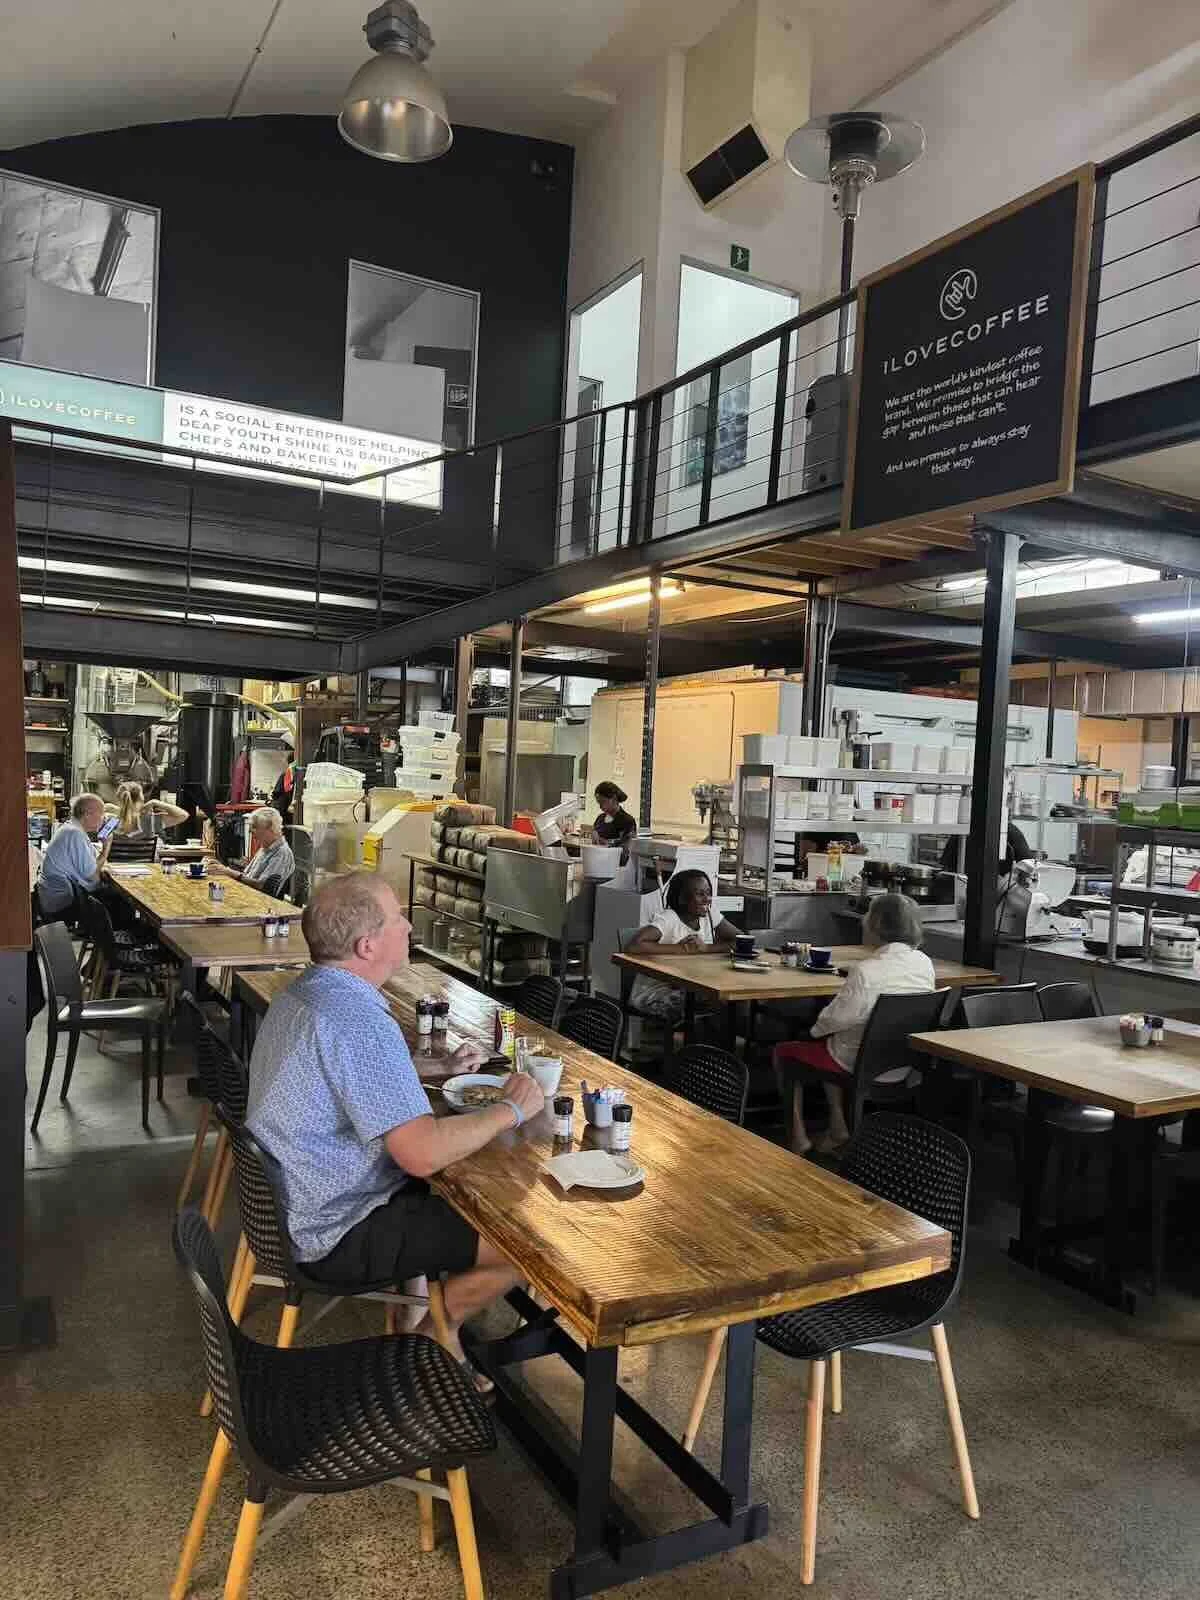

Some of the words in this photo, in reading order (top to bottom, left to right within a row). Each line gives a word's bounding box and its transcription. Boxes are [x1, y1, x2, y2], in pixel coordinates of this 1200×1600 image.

[882, 294, 1049, 375] ILOVECOFFEE
[885, 398, 900, 409] We
[901, 391, 915, 403] are
[916, 386, 932, 399] the
[970, 357, 1006, 378] kindest
[1008, 344, 1043, 364] coffee
[916, 398, 932, 411] We
[972, 380, 984, 392] to
[986, 367, 1020, 387] bridge
[1021, 361, 1040, 375] the
[11, 392, 137, 426] ILOVECOFFEE
[902, 411, 941, 430] between
[971, 391, 993, 406] that
[994, 386, 1013, 400] can
[1015, 376, 1041, 392] hear
[178, 431, 233, 449] CHEFS
[239, 441, 272, 456] AND
[277, 448, 338, 468] BAKERS
[342, 460, 357, 472] IN
[179, 403, 194, 416] IS
[199, 408, 209, 418] A
[215, 410, 272, 430] SOCIAL
[276, 422, 368, 448] ENTERPRISE
[370, 440, 431, 461] HELPING
[179, 417, 222, 433] DEAF
[227, 426, 280, 443] YOUTH
[286, 437, 330, 454] SHINE
[335, 447, 354, 458] AS
[904, 458, 919, 468] we
[919, 447, 957, 466] promise
[959, 442, 969, 453] to
[970, 431, 1007, 449] always
[1006, 423, 1032, 440] stay
[908, 425, 927, 441] and
[931, 460, 952, 475] that
[952, 455, 975, 470] way.
